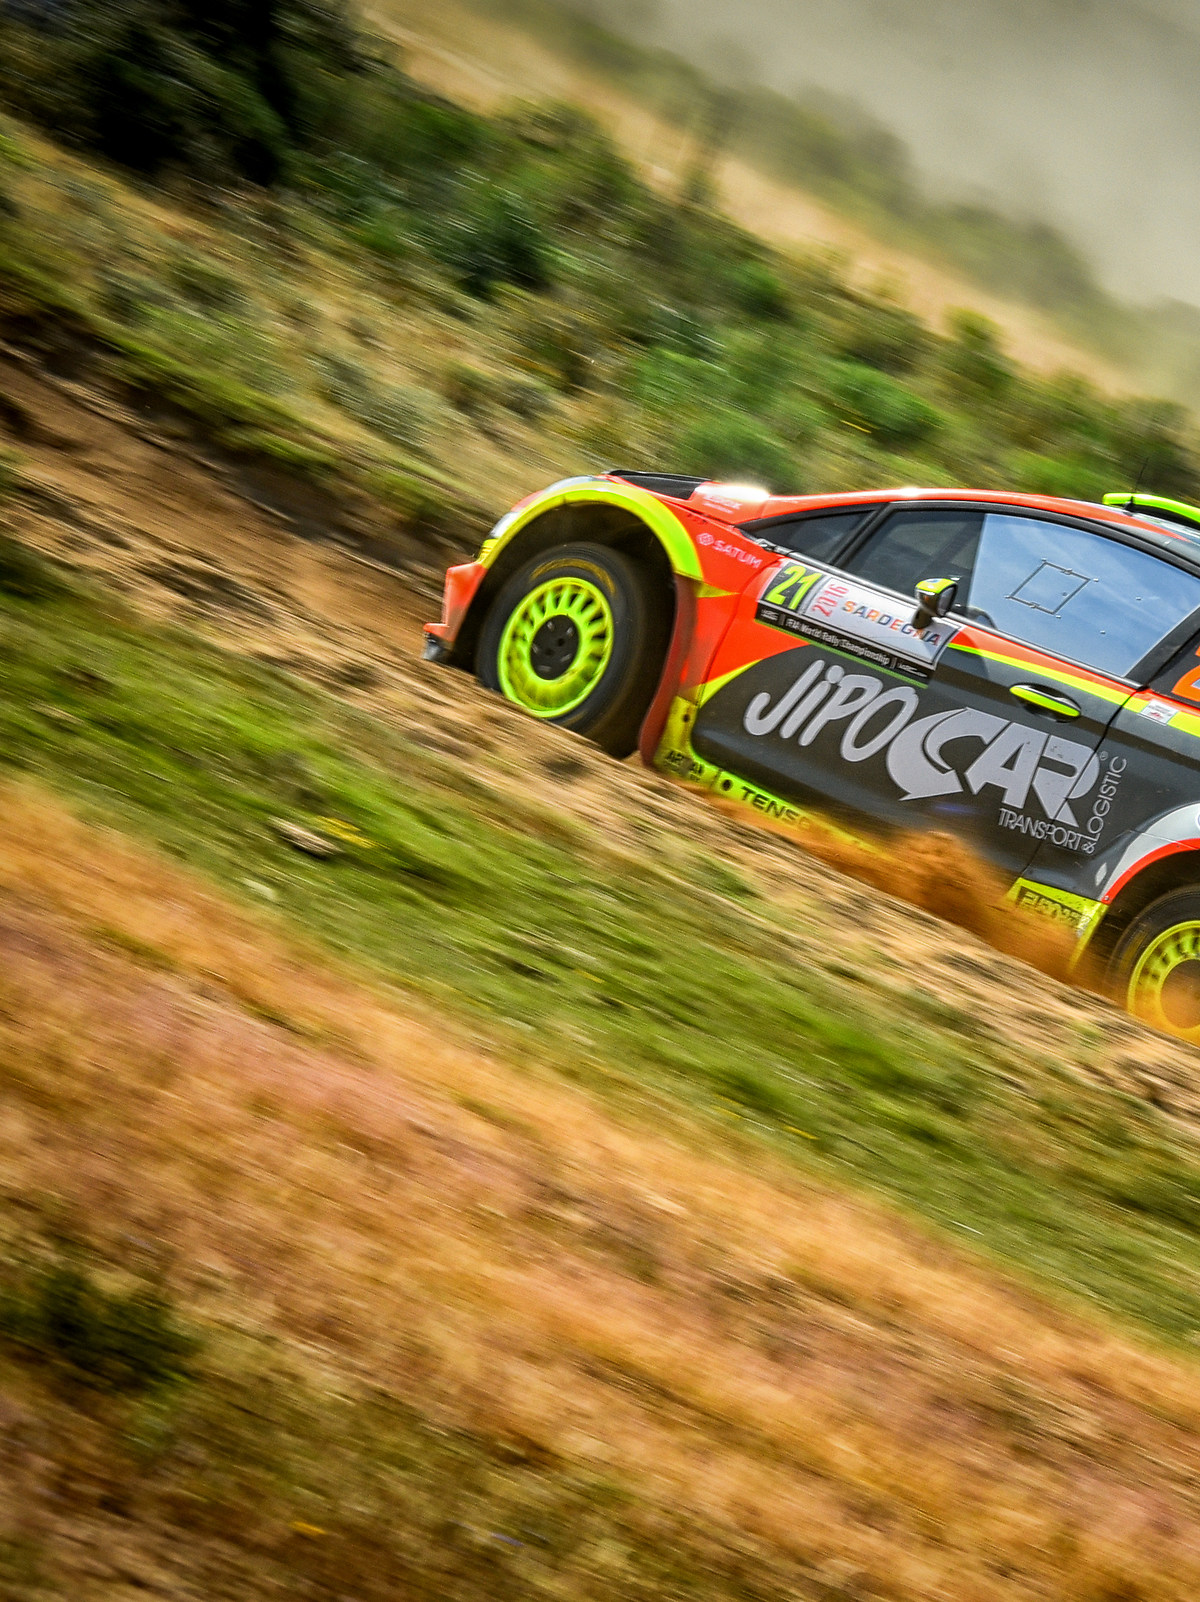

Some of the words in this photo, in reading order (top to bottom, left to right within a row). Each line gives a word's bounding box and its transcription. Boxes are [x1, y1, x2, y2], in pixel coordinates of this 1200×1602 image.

[765, 565, 823, 610] 21
[812, 583, 850, 617] 2016
[841, 600, 941, 646] SARDEGNA
[1077, 756, 1127, 842] LOGISTIC
[998, 808, 1083, 851] TRANSPORT
